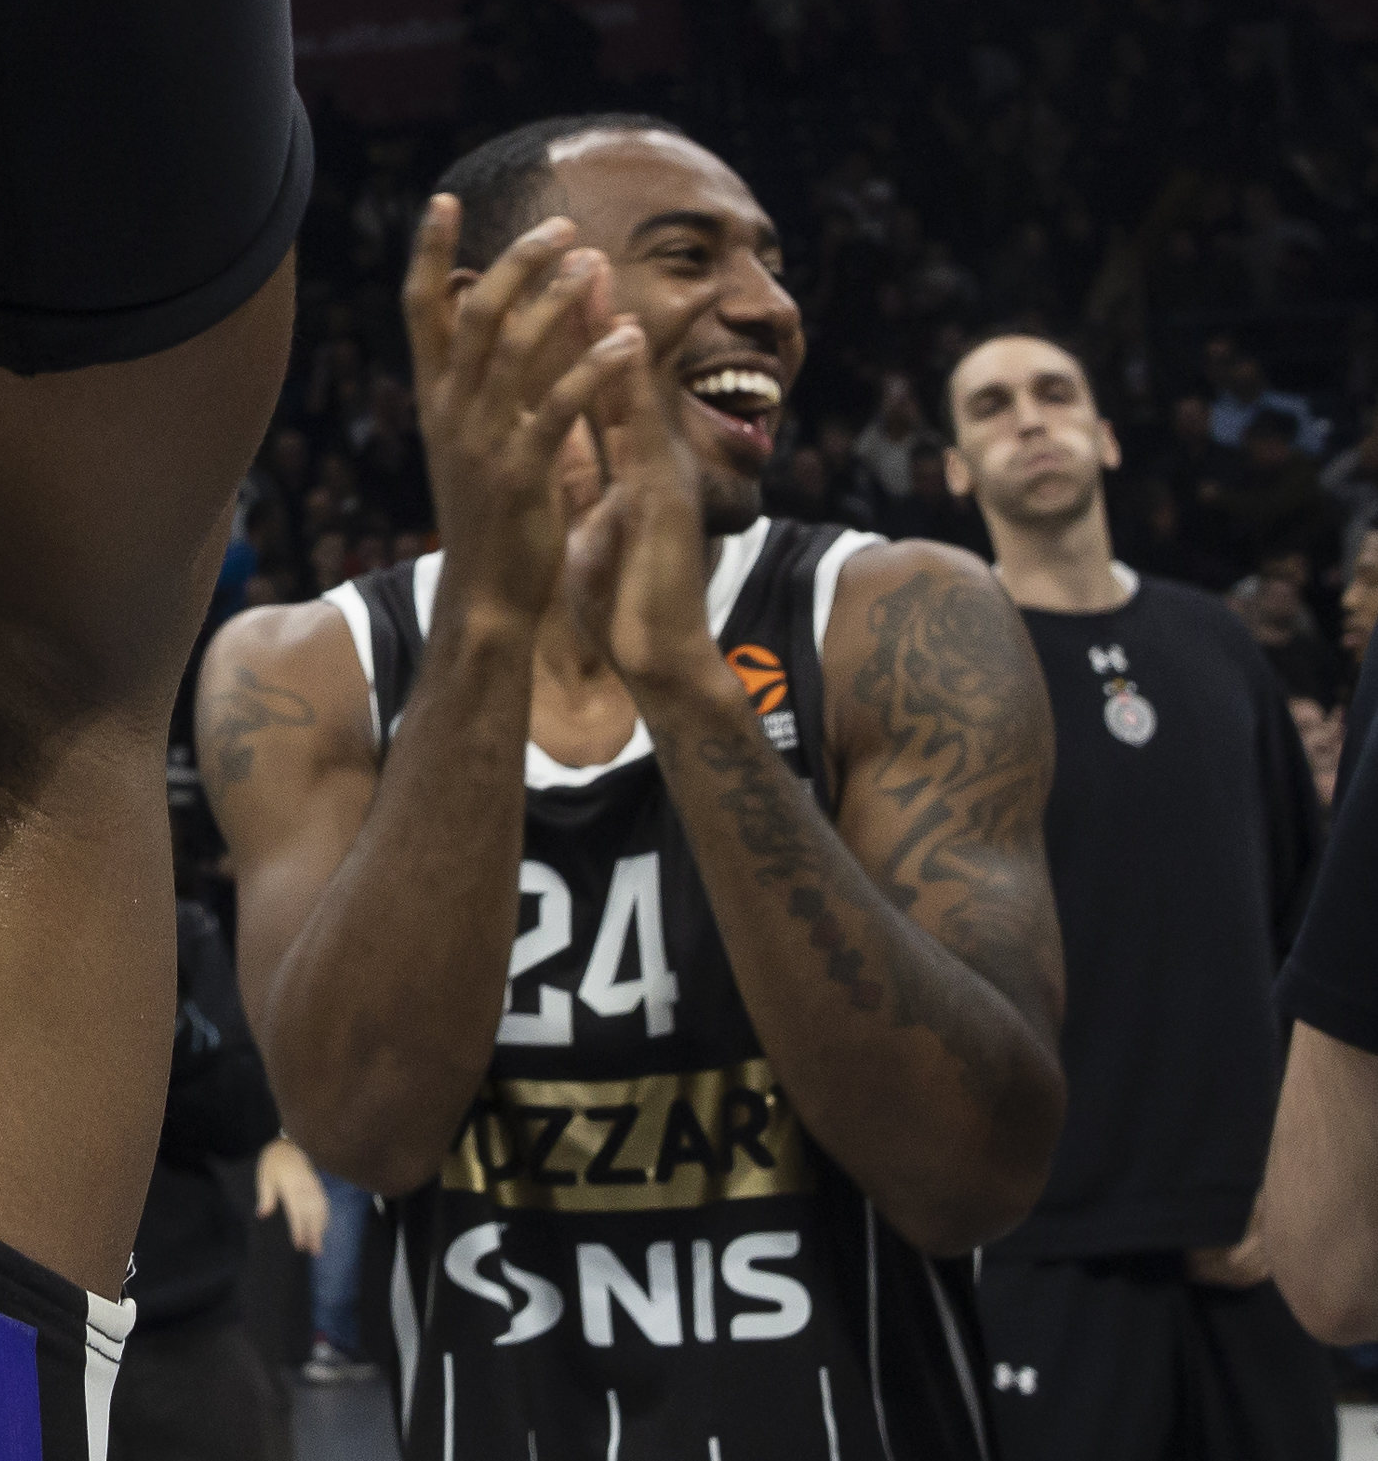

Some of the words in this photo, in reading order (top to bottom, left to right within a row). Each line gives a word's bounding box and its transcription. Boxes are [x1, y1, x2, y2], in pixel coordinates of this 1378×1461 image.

[495, 851, 680, 1047] 24
[454, 1081, 790, 1188] OZZAR
[576, 1230, 813, 1348] NIS
